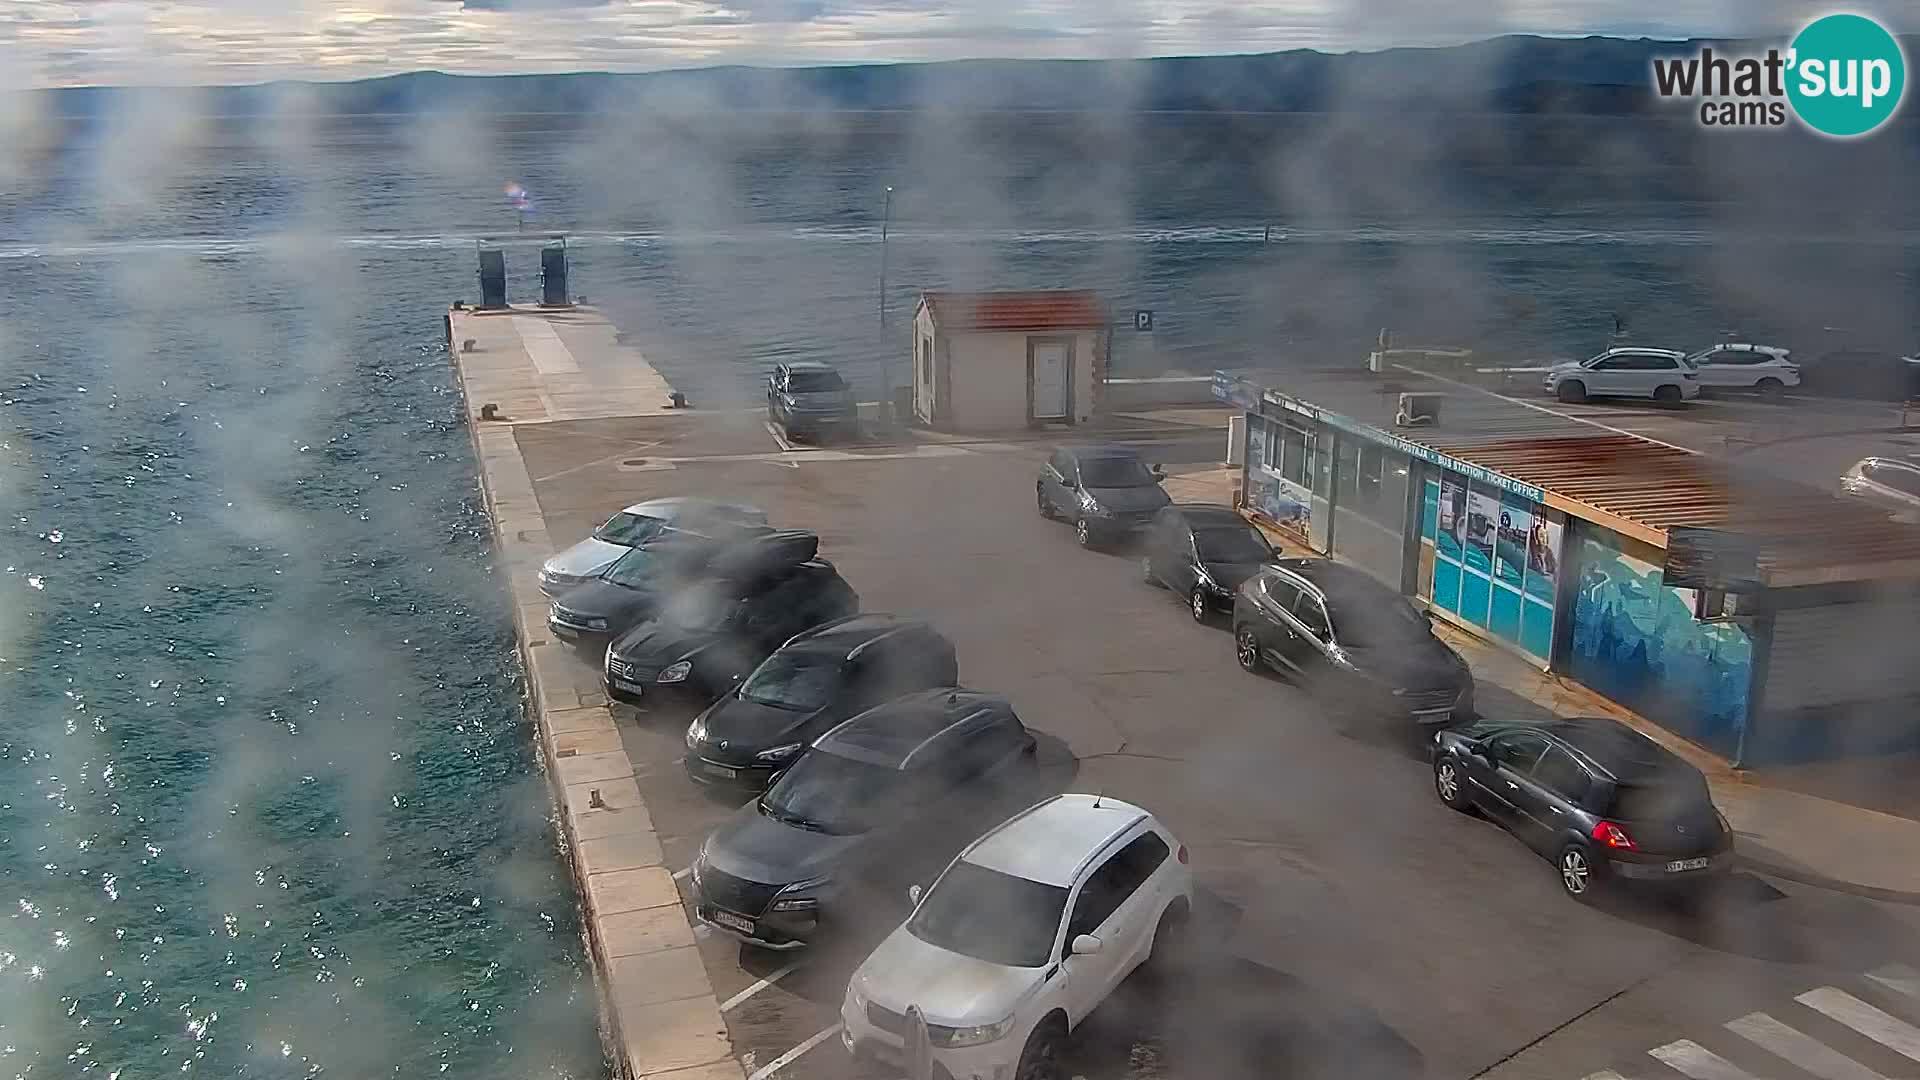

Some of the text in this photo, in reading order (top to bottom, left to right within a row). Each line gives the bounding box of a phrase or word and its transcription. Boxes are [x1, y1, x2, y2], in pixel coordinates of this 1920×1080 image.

[1139, 313, 1149, 328] P
[1439, 456, 1451, 468] BUS
[1453, 461, 1484, 480] STATION
[1486, 472, 1511, 489] TICKET
[1512, 482, 1539, 500] OFFICE
